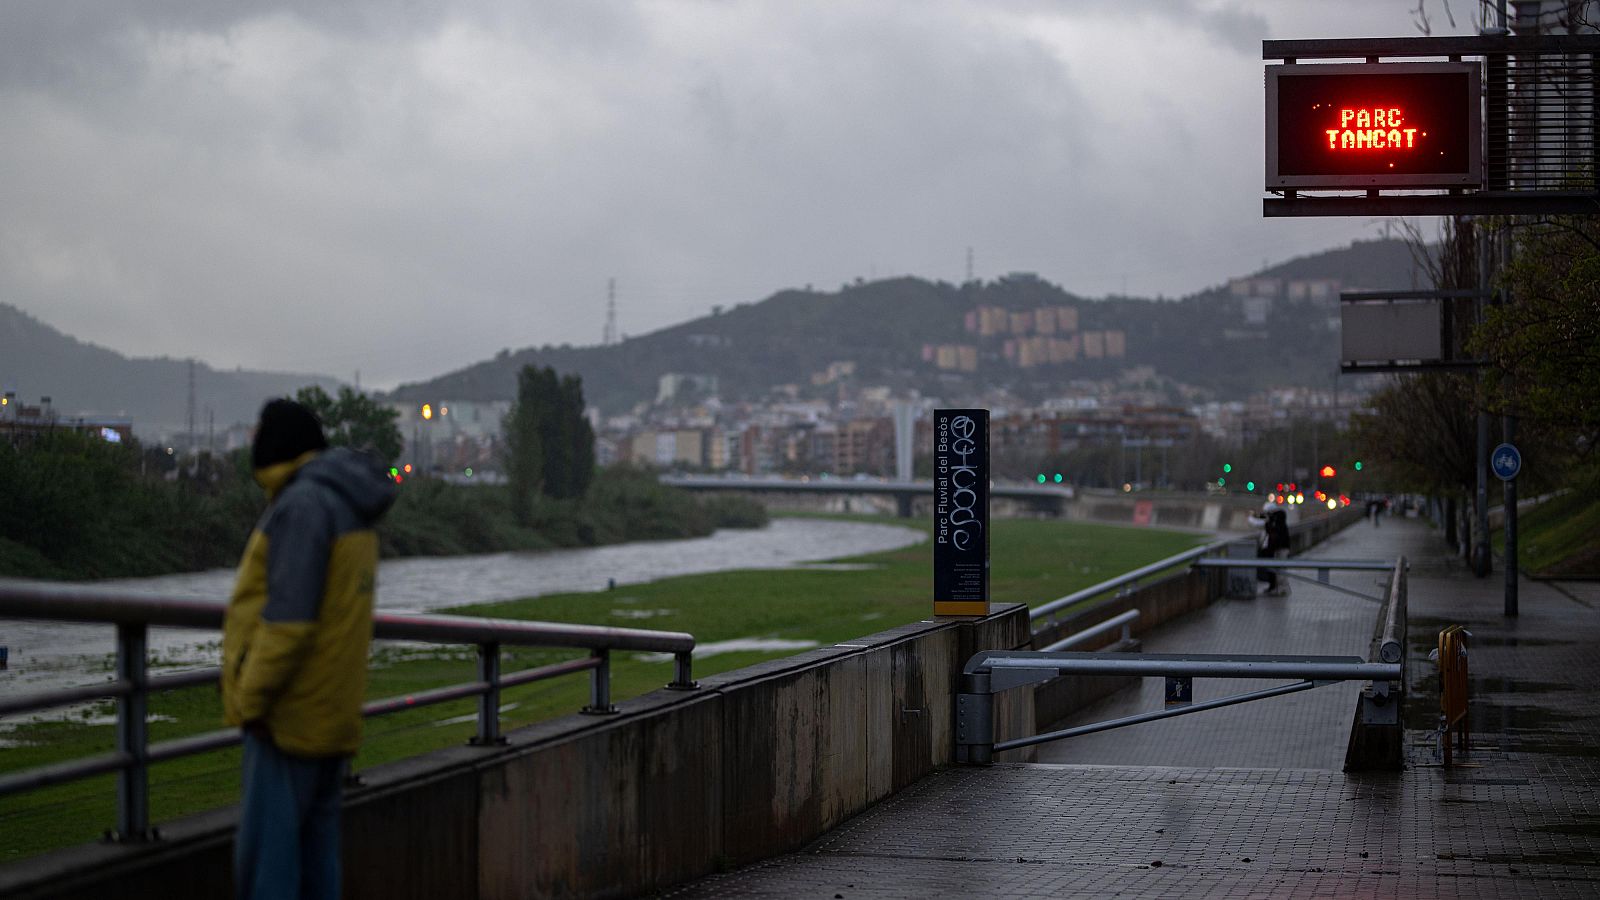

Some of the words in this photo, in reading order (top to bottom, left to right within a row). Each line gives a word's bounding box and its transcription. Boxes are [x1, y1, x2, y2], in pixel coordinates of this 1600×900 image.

[1341, 108, 1401, 128] PARC
[1325, 128, 1417, 149] TANCAT
[938, 416, 948, 452] Besòs
[938, 456, 948, 474] del
[938, 477, 948, 513] Fluvial
[938, 517, 948, 544] Parc
